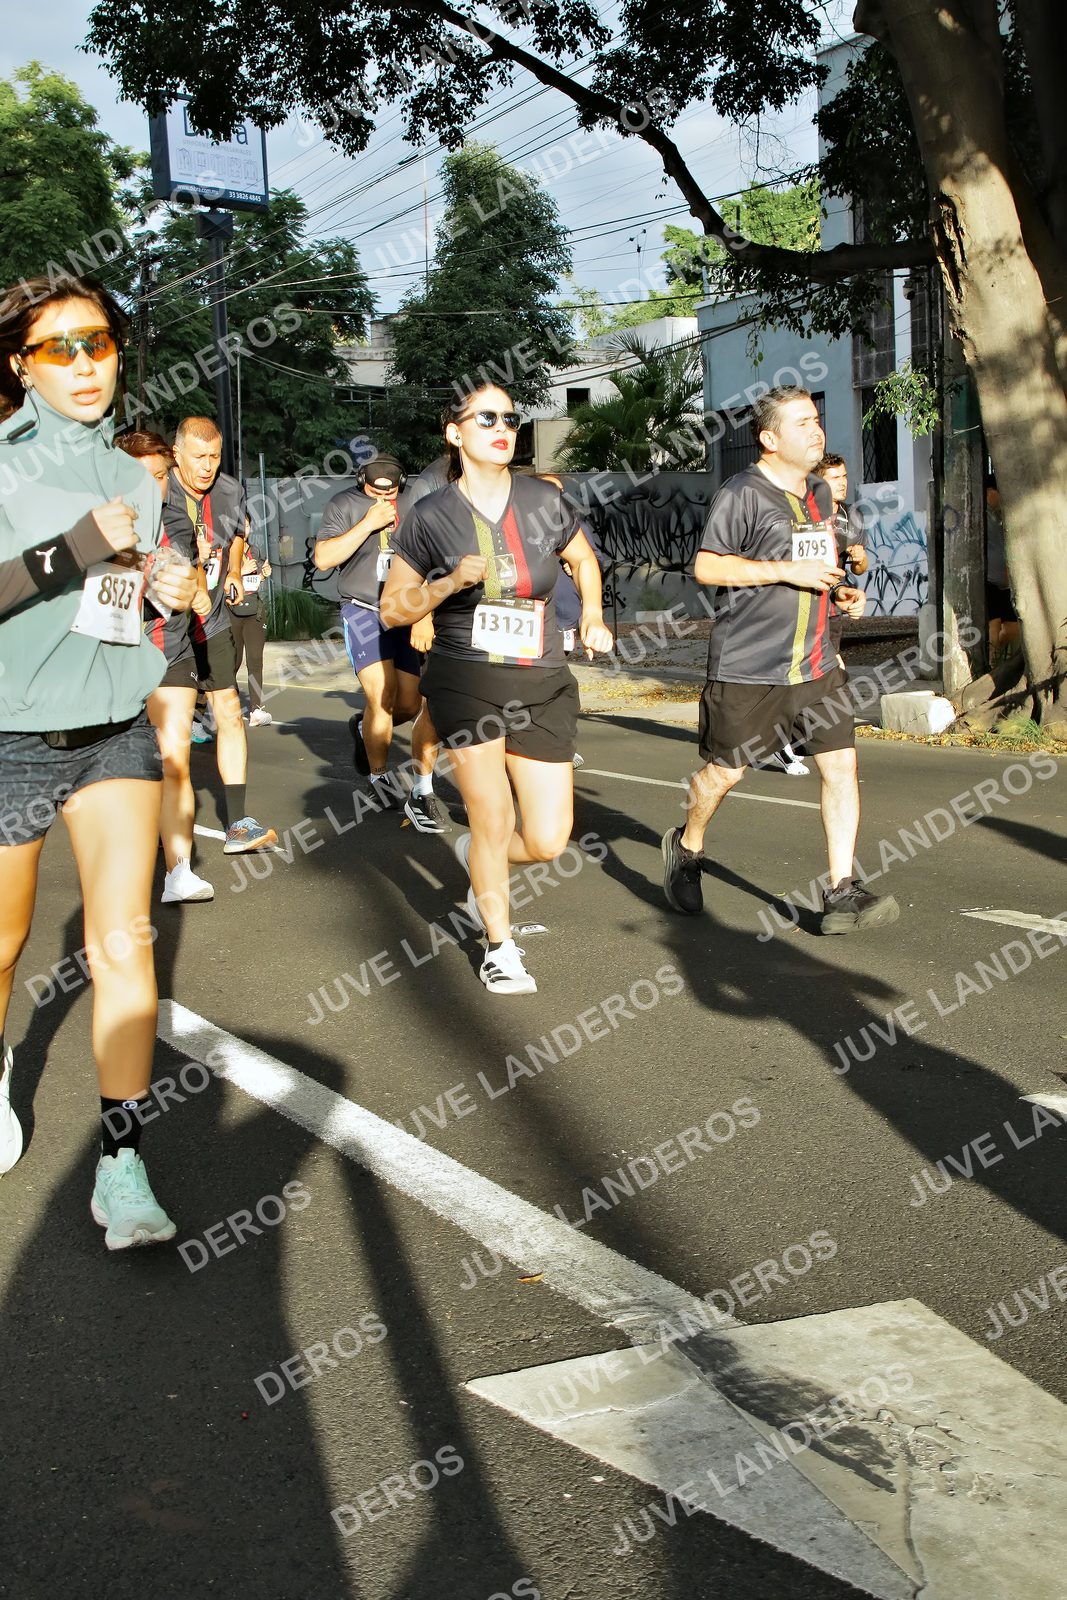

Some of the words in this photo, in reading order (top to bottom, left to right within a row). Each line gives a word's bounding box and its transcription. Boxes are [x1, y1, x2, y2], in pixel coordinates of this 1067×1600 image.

[798, 540, 827, 557] 8795
[97, 575, 135, 610] 8523
[478, 612, 534, 637] 13121
